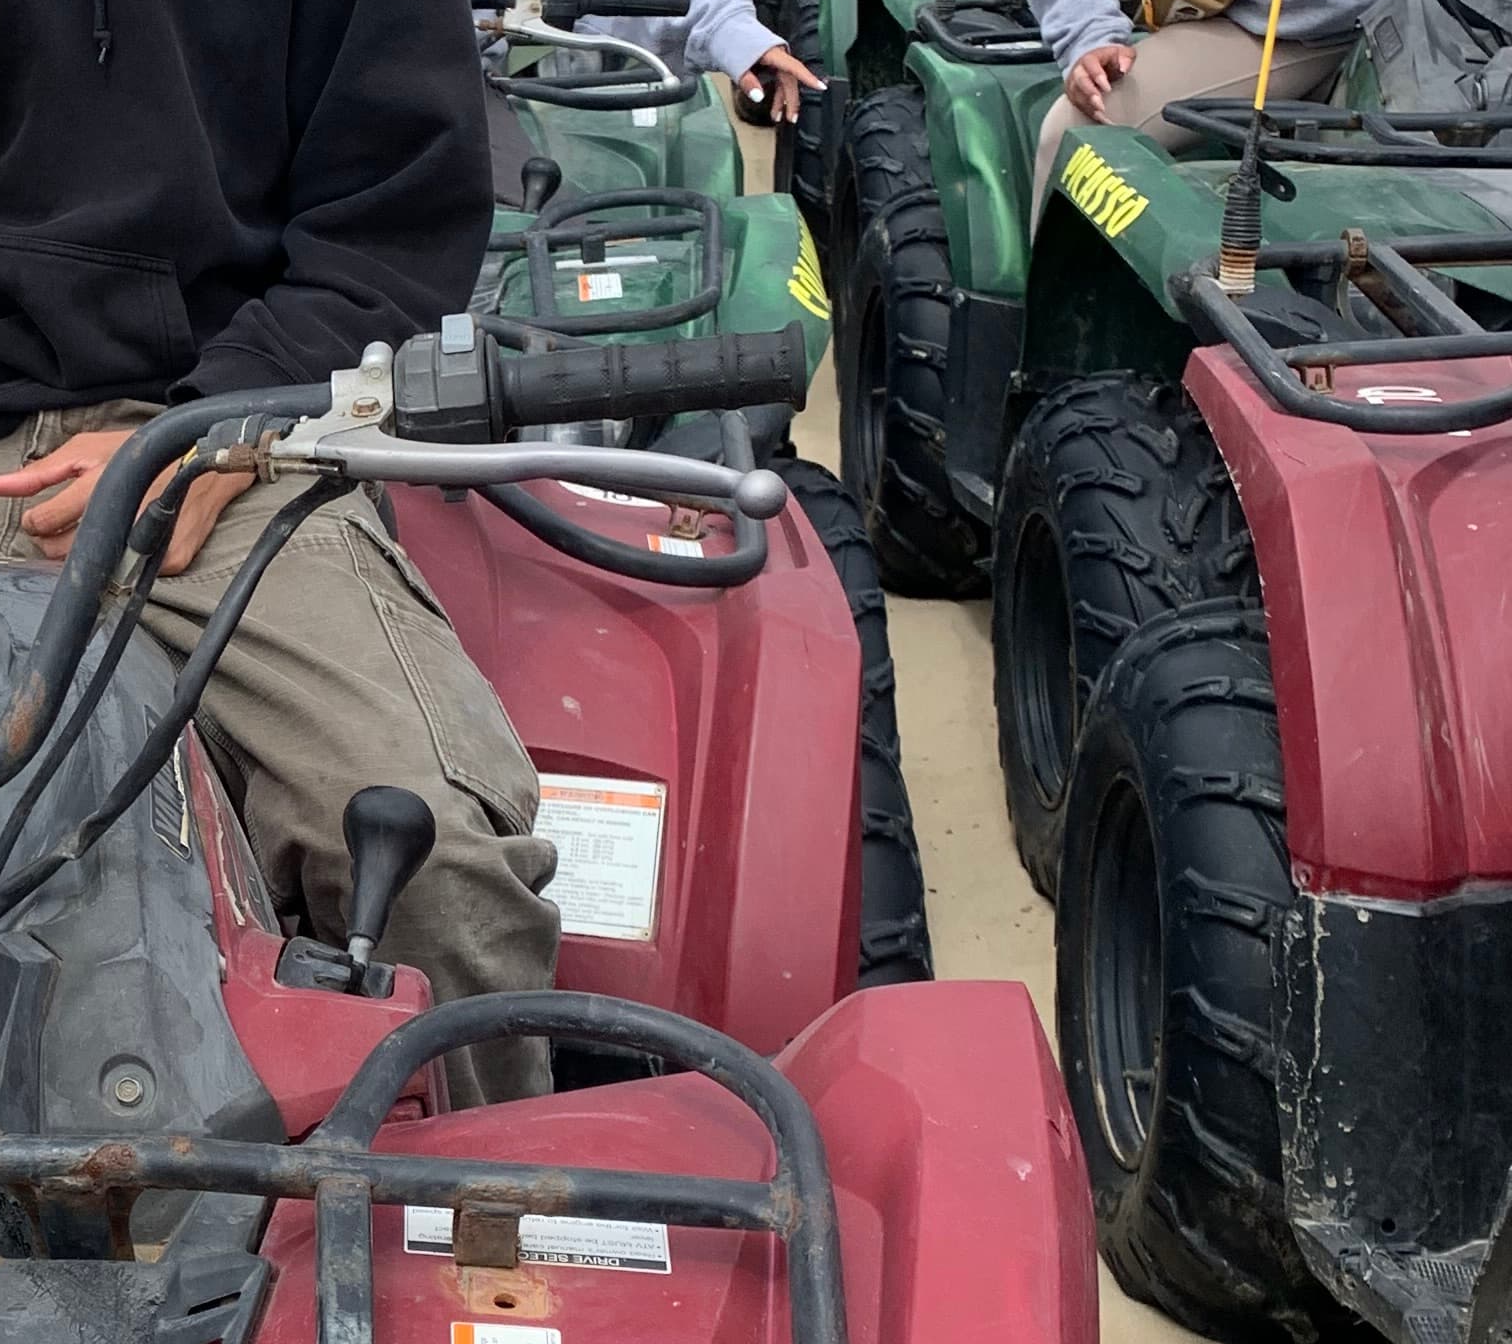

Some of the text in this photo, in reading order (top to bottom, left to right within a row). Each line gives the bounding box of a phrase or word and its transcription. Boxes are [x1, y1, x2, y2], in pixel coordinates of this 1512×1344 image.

[1060, 143, 1150, 238] PICASSO
[518, 1252, 620, 1266] DRIVE SELEC
